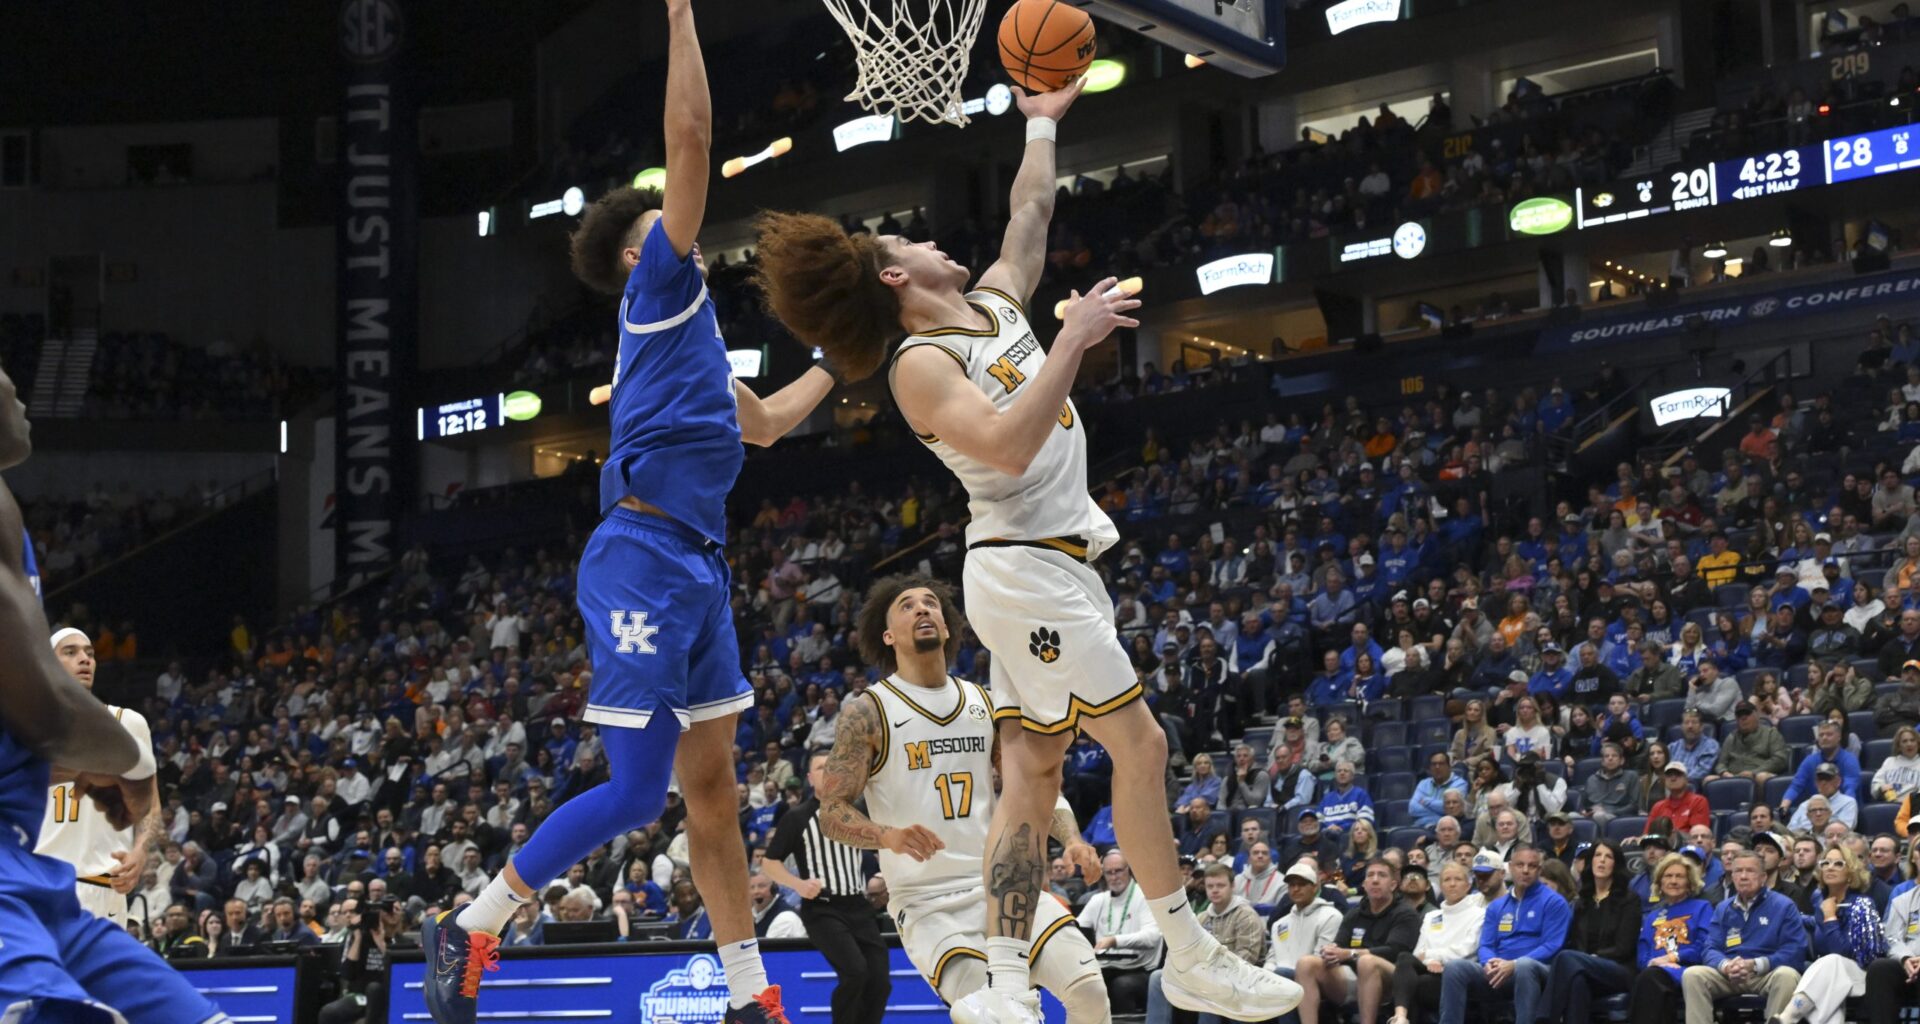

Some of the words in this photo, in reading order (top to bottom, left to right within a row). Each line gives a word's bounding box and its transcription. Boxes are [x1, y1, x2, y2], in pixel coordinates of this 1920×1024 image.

[344, 0, 401, 55] SEC
[1333, 1, 1394, 21] FarmRich
[347, 84, 390, 132] IT
[1739, 150, 1801, 183] 4:23
[1832, 137, 1873, 170] 28
[1671, 168, 1709, 201] 20
[347, 143, 390, 279] JUST
[1674, 196, 1709, 211] BONUS
[1204, 260, 1266, 283] FarmRich
[347, 298, 390, 496] MEANS
[438, 409, 486, 436] 12:12
[610, 610, 659, 654] UK
[904, 736, 985, 770] MISSOURI
[53, 785, 80, 823] 11
[934, 771, 973, 820] 17
